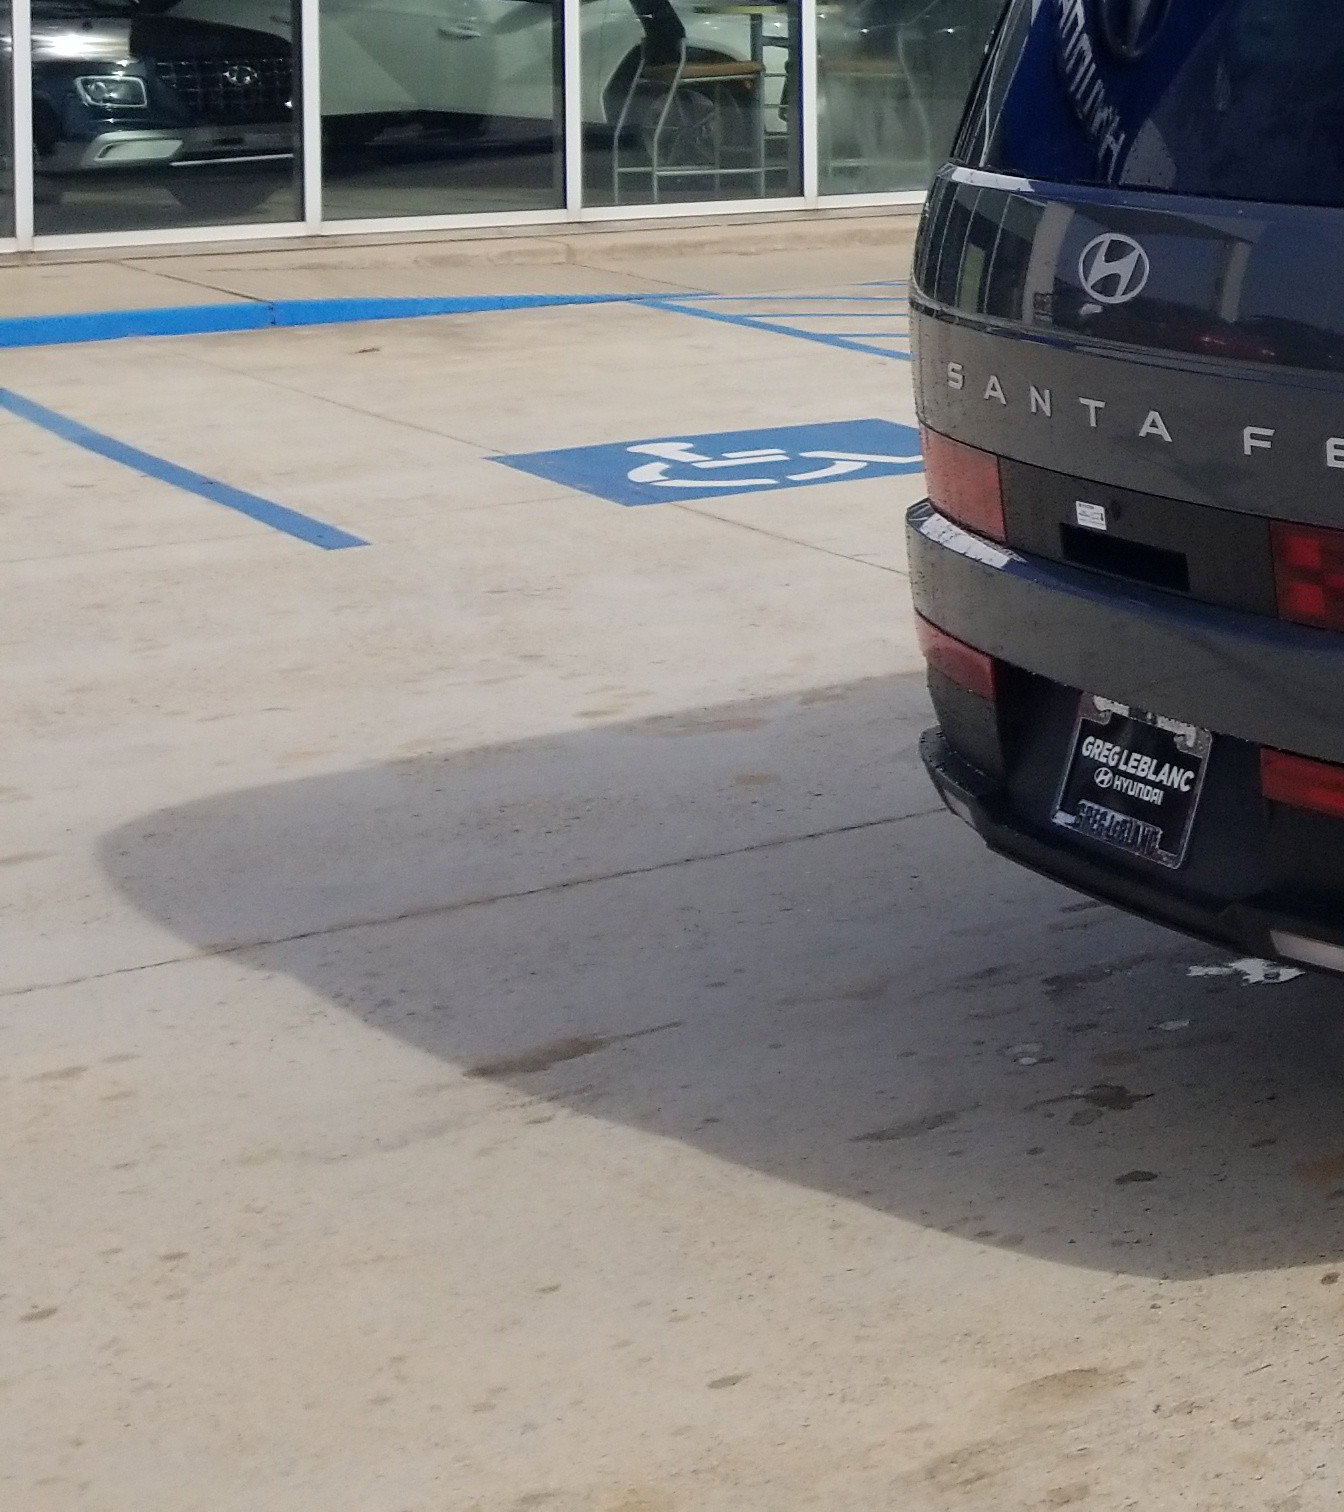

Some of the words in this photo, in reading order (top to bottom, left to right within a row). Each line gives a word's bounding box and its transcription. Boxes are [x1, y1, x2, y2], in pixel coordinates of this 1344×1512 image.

[946, 363, 1173, 442] SANTA
[1082, 736, 1120, 767] GREG
[1118, 749, 1195, 791] LEBLANC
[1113, 775, 1165, 805] HYUNDAI
